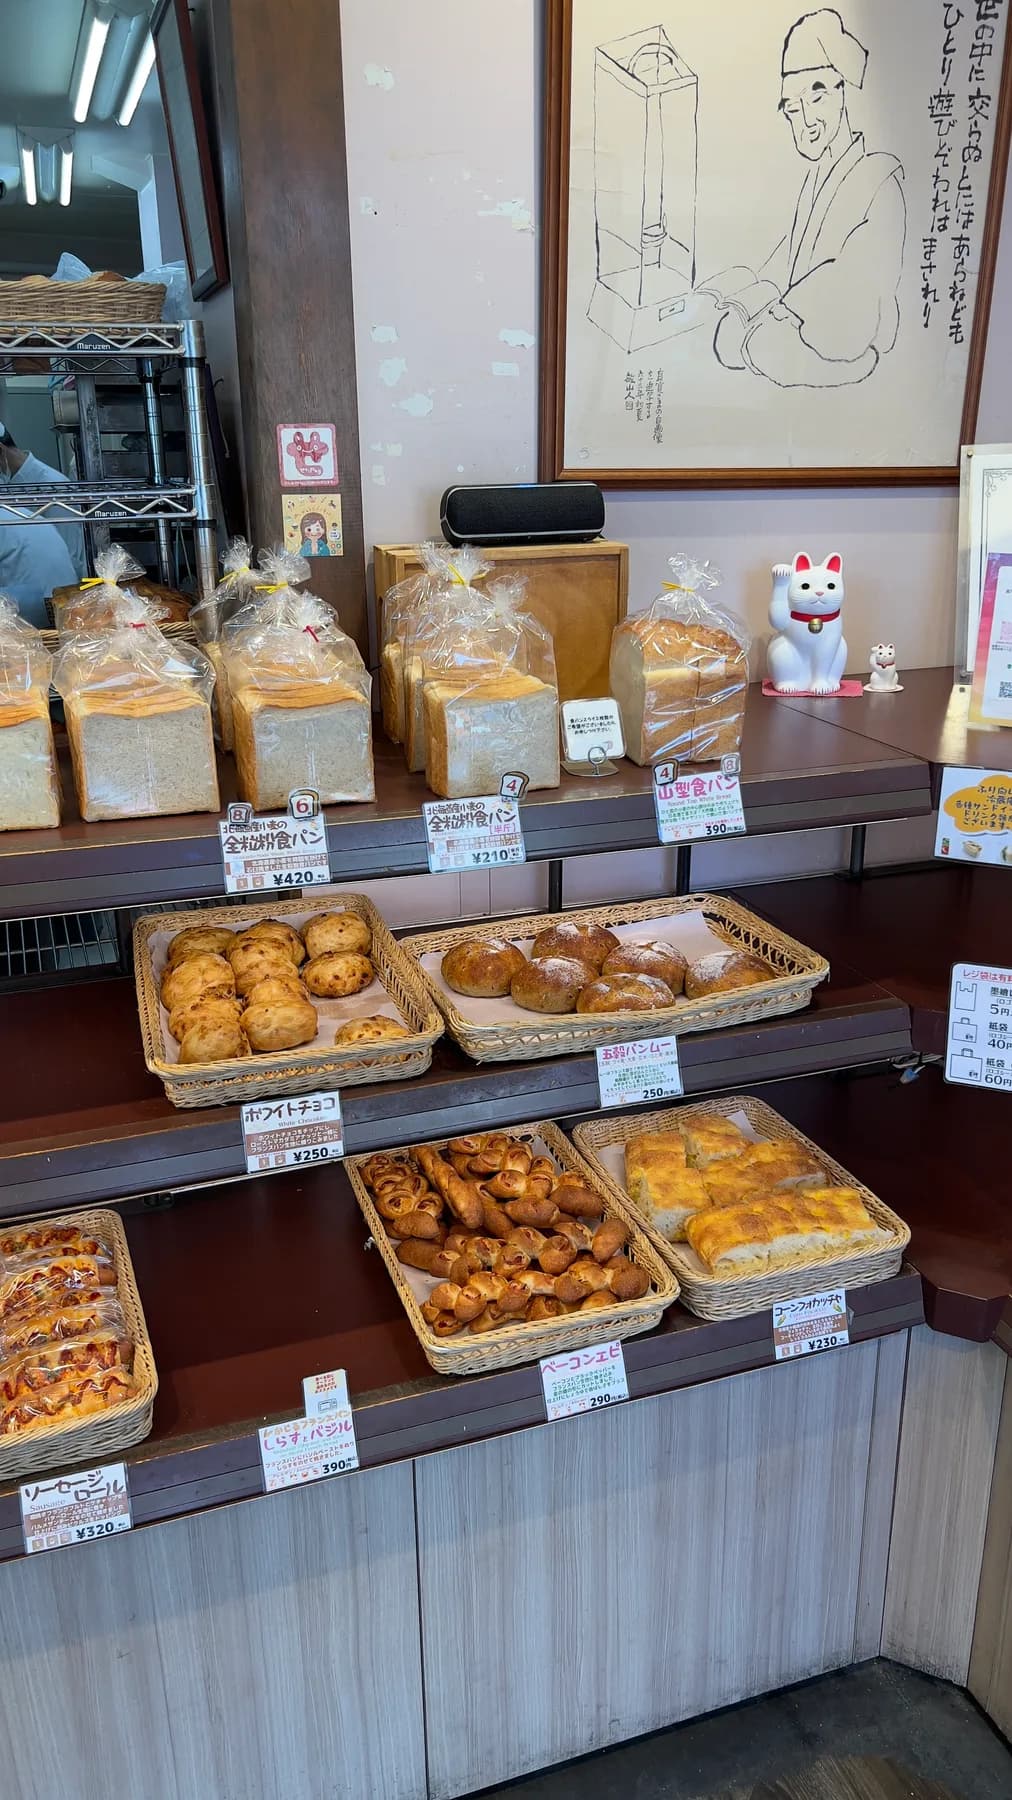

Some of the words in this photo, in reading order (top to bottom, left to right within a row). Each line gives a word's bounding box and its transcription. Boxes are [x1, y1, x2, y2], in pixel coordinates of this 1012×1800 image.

[726, 760, 734, 770] 8
[660, 767, 669, 778] 4
[506, 779, 517, 792] 4
[658, 775, 738, 800] 山型食パン
[296, 798, 309, 813] 6
[427, 801, 486, 815] 北海道産小麦の
[955, 800, 1012, 813] 各種サンドイ
[233, 810, 243, 820] 8
[428, 809, 516, 832] 全粒粉食パン
[223, 829, 323, 854] 全粒粉食パン
[472, 849, 508, 864] ¥210
[273, 871, 314, 885] ¥420
[988, 1022, 1008, 1032] 紙袋
[987, 1038, 1012, 1050] 40円
[986, 1058, 1006, 1068] 紙袋
[984, 1073, 1012, 1087] 60円
[245, 1097, 336, 1122] ホワイトチョコ
[293, 1147, 328, 1161] ¥250
[775, 1294, 842, 1316] コーンフォカッチャ
[808, 1336, 837, 1350] ¥230
[542, 1342, 620, 1373] ベーコンエピ
[264, 1420, 353, 1450] しらすとバジル
[24, 1470, 104, 1501] ソーセージ
[74, 1480, 124, 1501] ロール
[76, 1522, 114, 1539] ¥320
